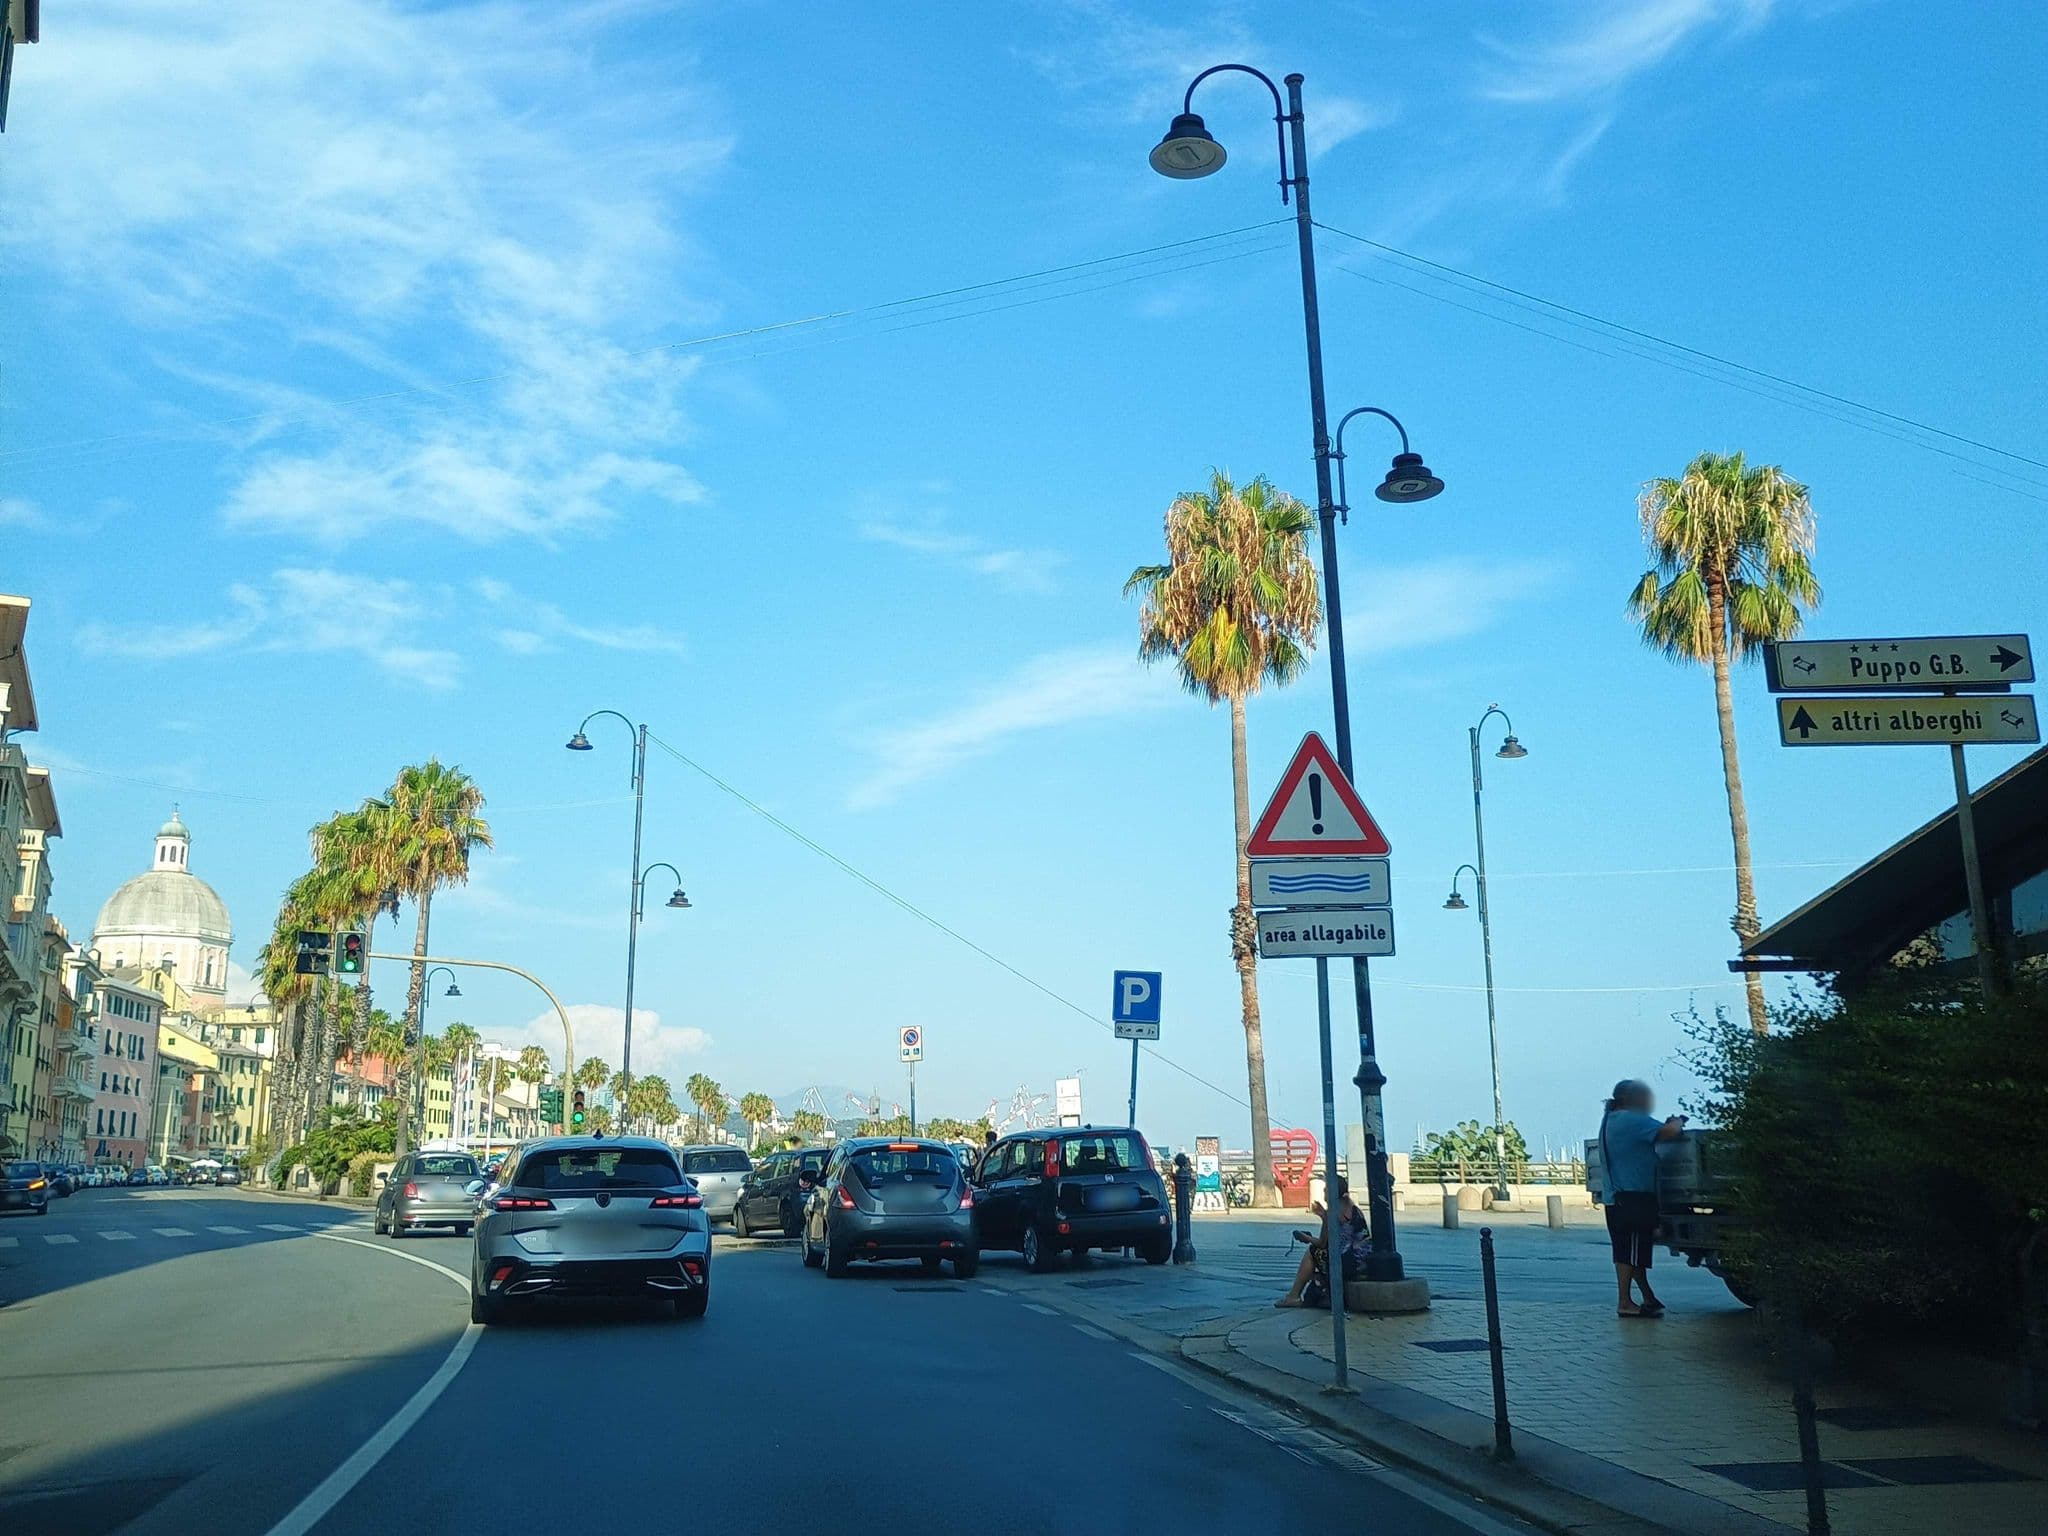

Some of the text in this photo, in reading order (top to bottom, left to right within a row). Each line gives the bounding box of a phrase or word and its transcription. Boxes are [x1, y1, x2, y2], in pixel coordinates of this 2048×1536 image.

[1850, 654, 1970, 683] Puppo G.B.
[1832, 709, 1982, 735] altri alberghi
[1265, 924, 1386, 944] area allagabile
[1122, 976, 1151, 1015] P
